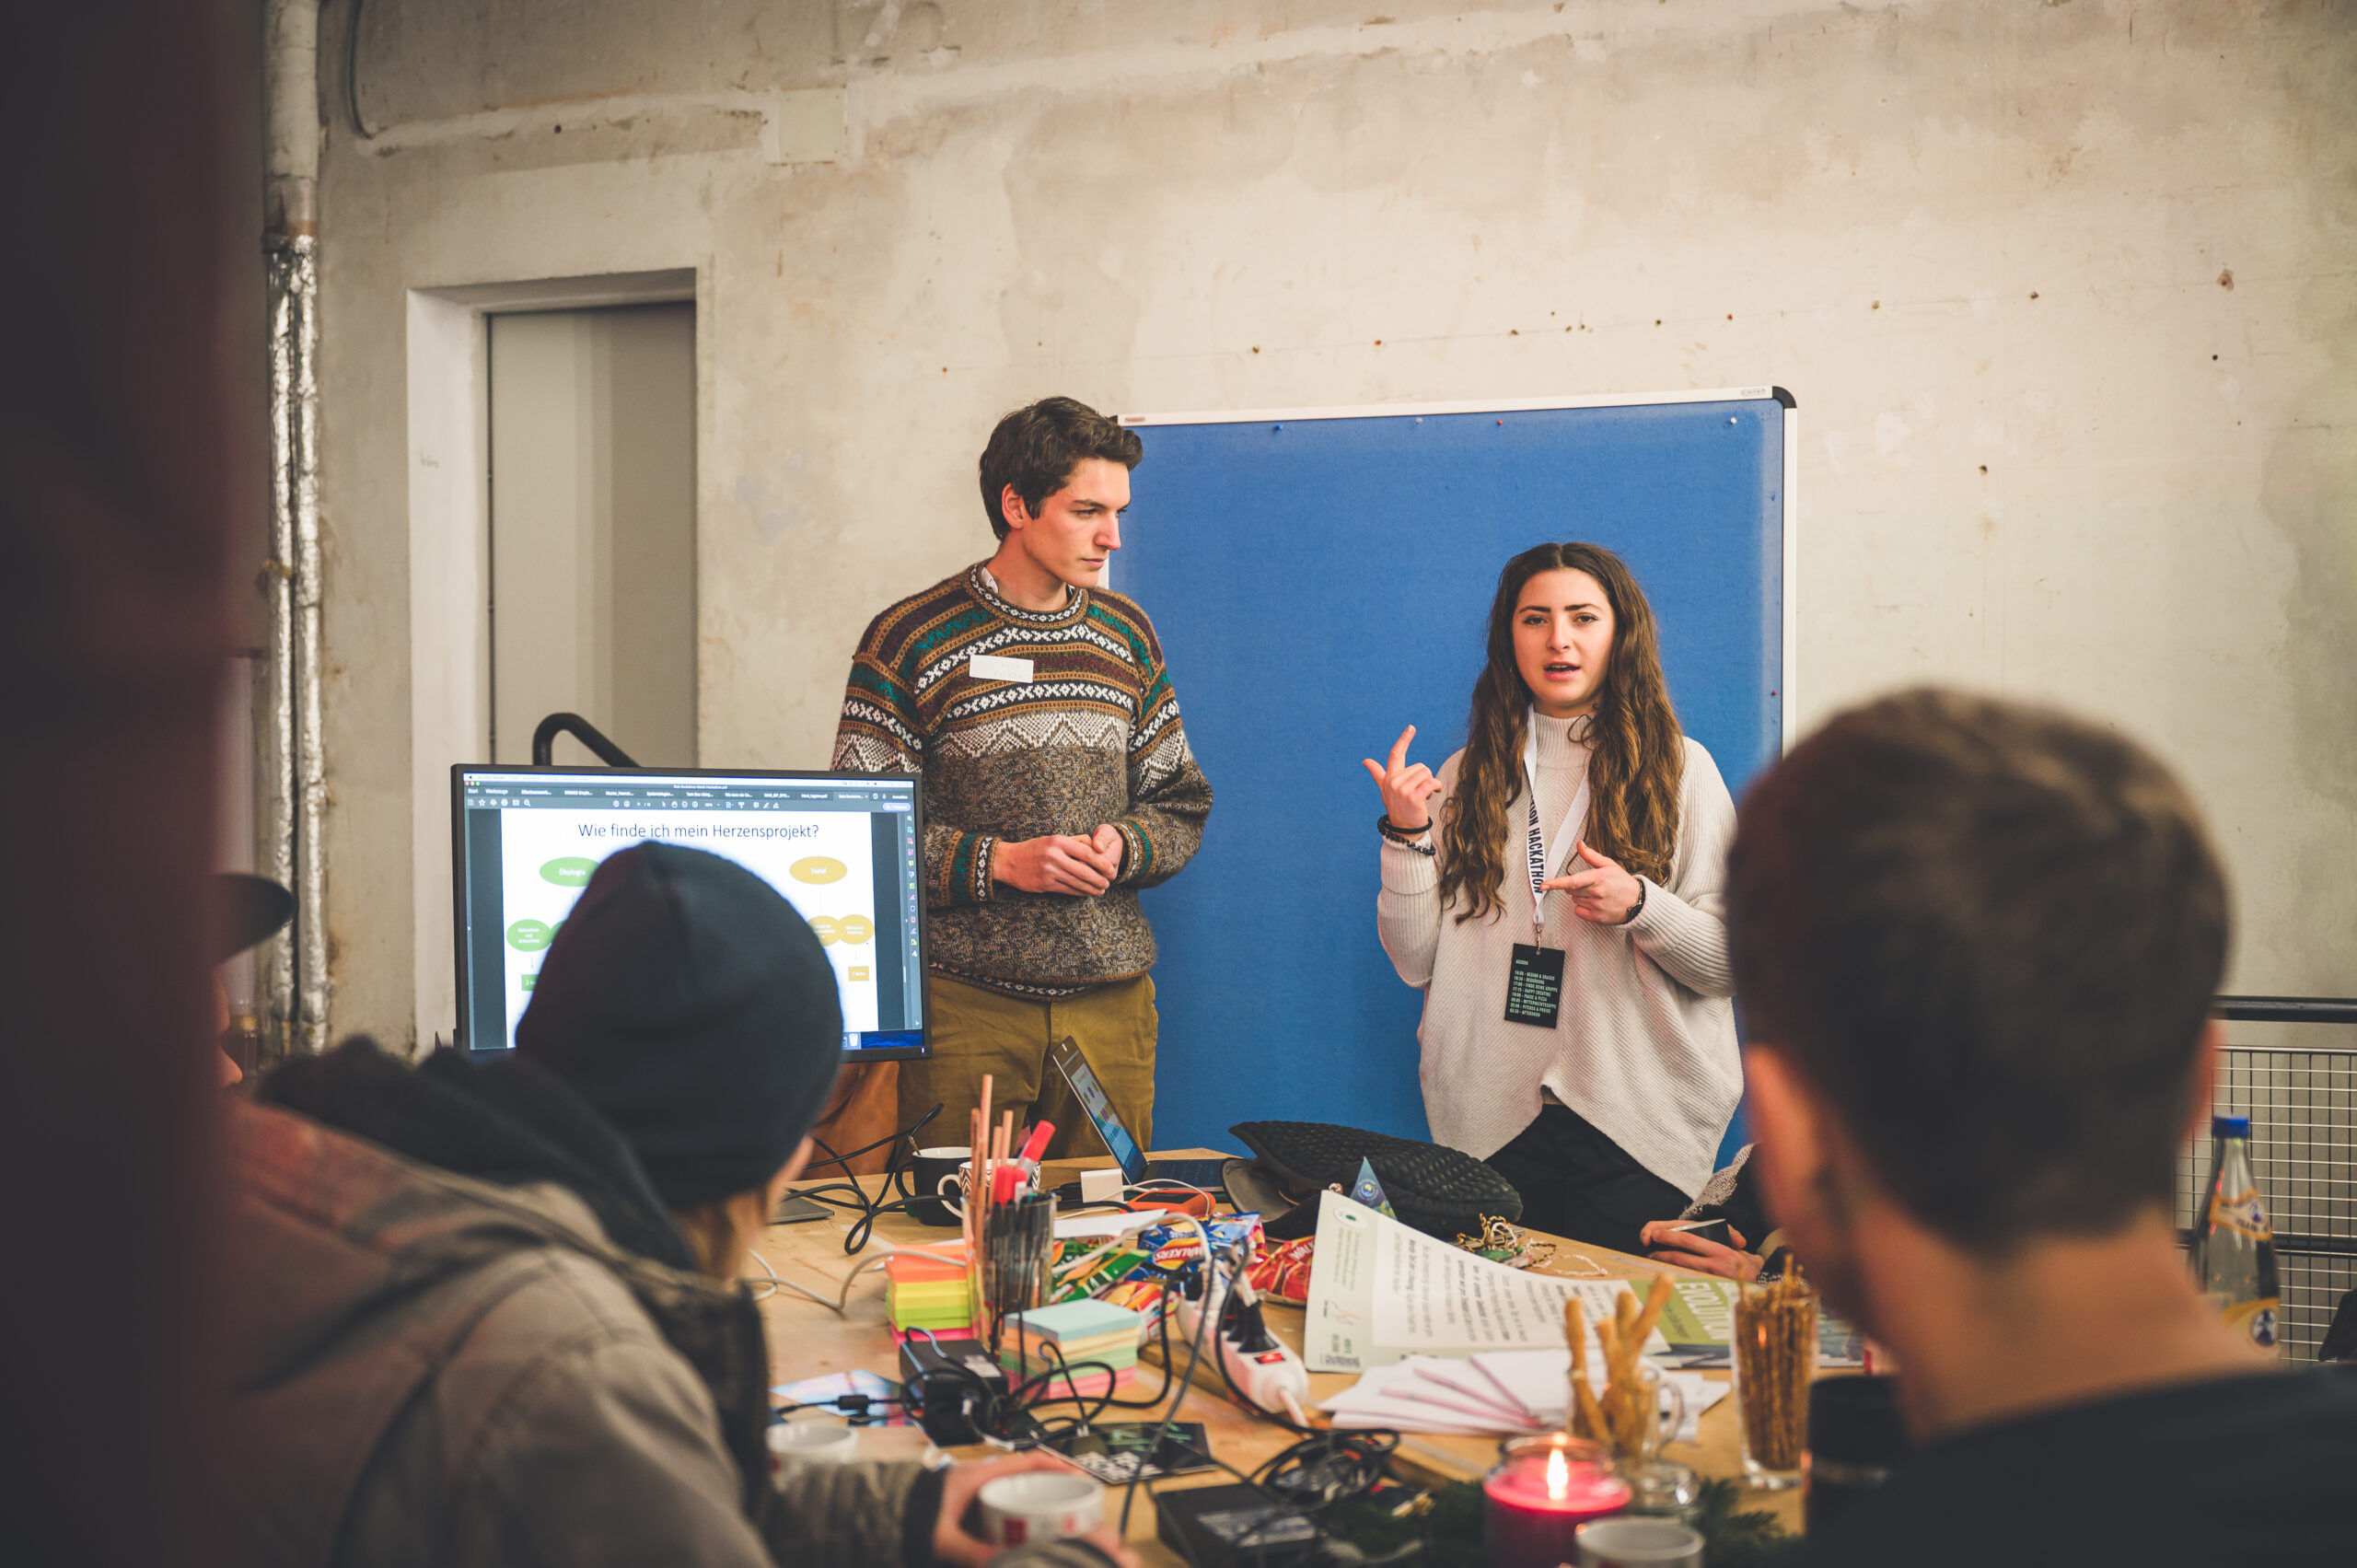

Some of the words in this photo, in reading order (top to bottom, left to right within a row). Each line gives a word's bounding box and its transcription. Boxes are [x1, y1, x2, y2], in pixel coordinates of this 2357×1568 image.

[578, 824, 607, 837] Wie
[611, 823, 646, 838] finde
[650, 824, 669, 838] ich
[675, 824, 708, 838] mein
[713, 824, 819, 841] Herzensprojekt?
[1528, 828, 1544, 894] HACKATHON
[559, 866, 586, 877] Ökologie
